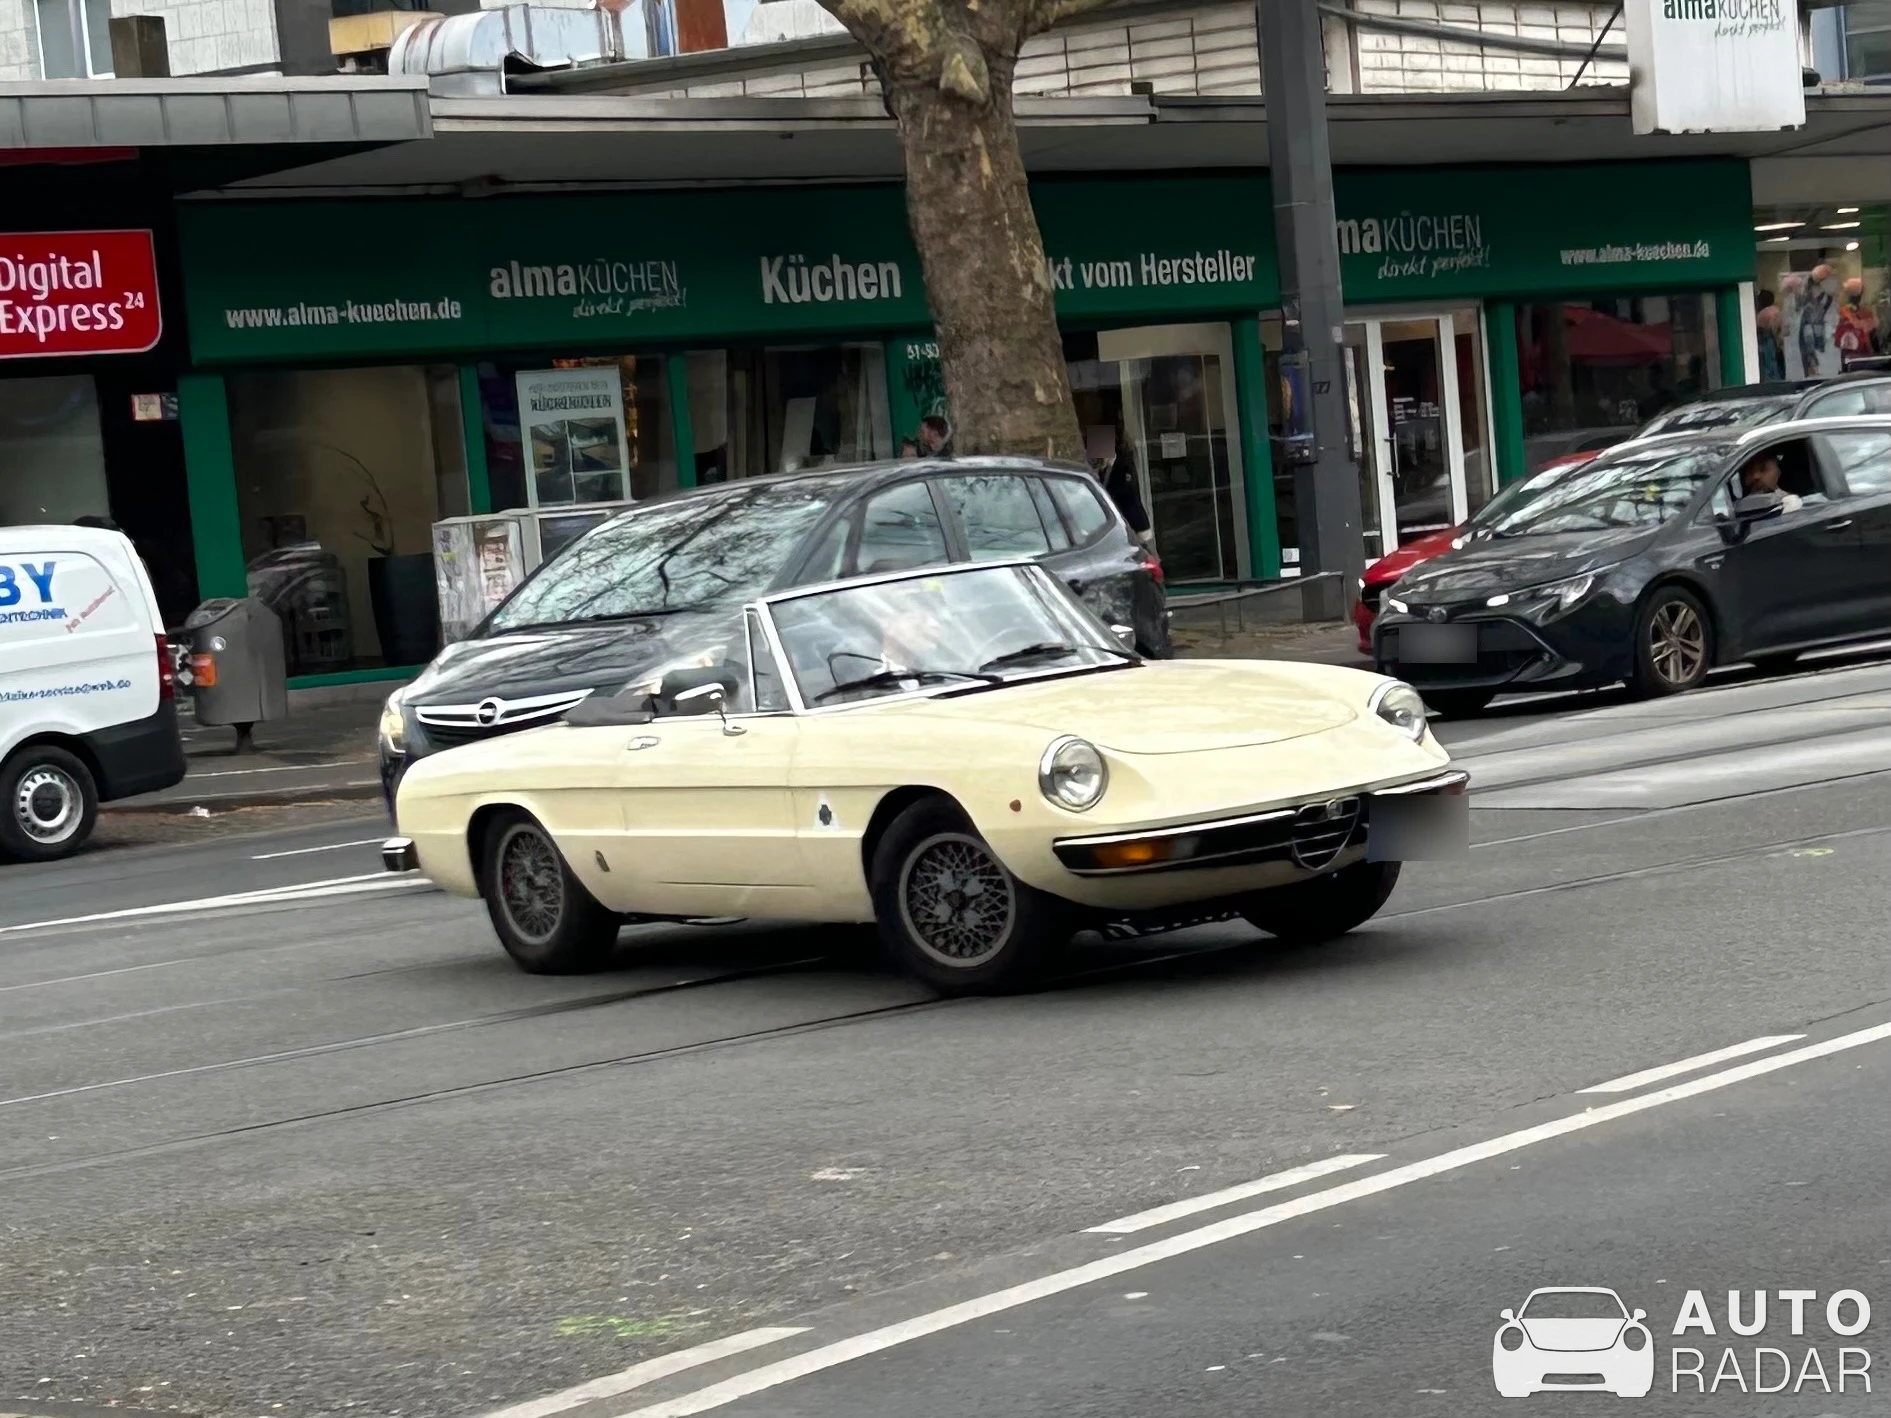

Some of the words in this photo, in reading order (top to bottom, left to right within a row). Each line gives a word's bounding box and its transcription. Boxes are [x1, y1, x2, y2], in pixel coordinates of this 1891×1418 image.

[0, 249, 103, 301] Digital
[760, 253, 903, 304] Küchen
[1080, 261, 1134, 289] vom
[1140, 249, 1256, 286] Hersteller
[0, 300, 124, 343] Express
[225, 297, 462, 328] www.alma-kuechen.de
